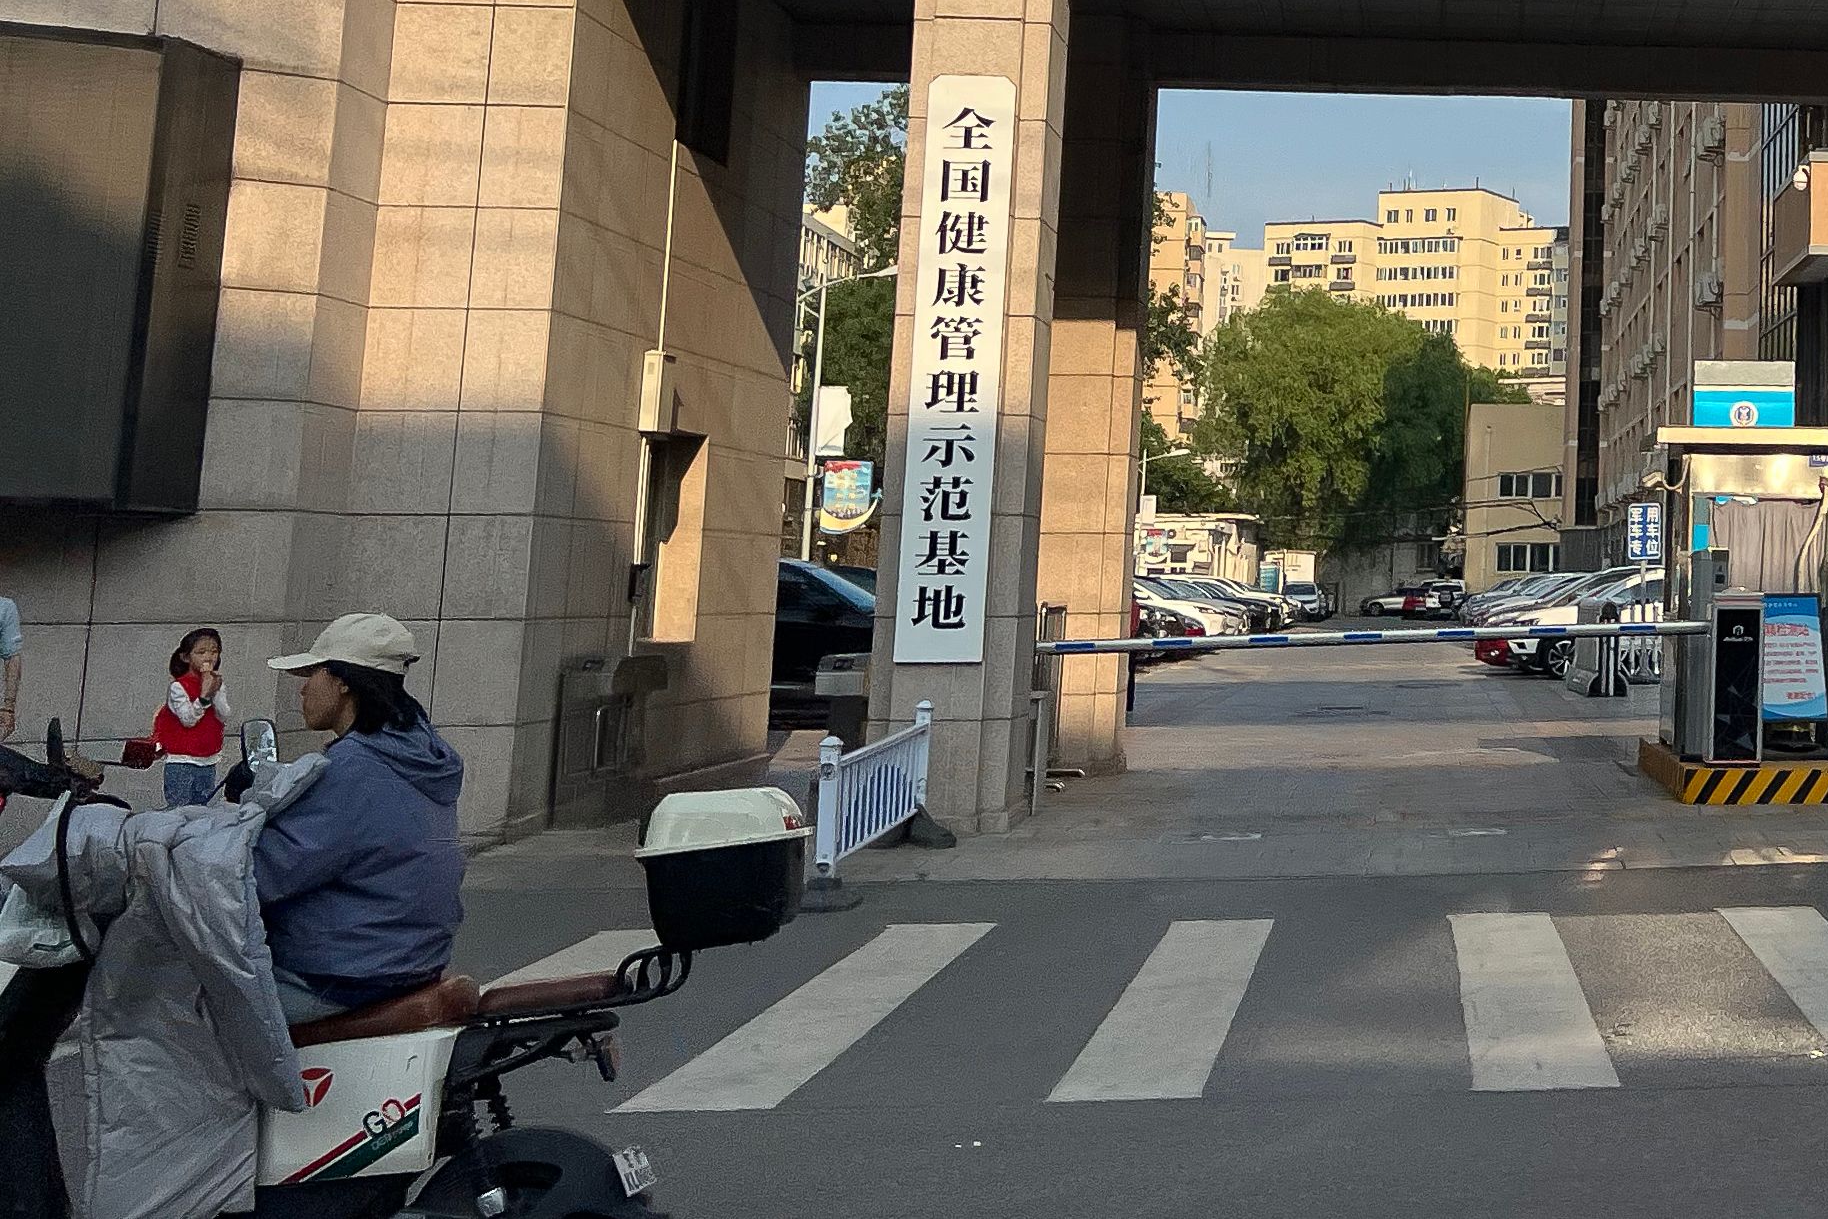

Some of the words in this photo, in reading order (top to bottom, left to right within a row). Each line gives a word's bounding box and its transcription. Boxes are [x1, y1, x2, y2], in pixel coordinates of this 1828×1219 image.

[910, 106, 997, 631] 全国健康管理示范基地
[362, 1098, 405, 1135] GO
